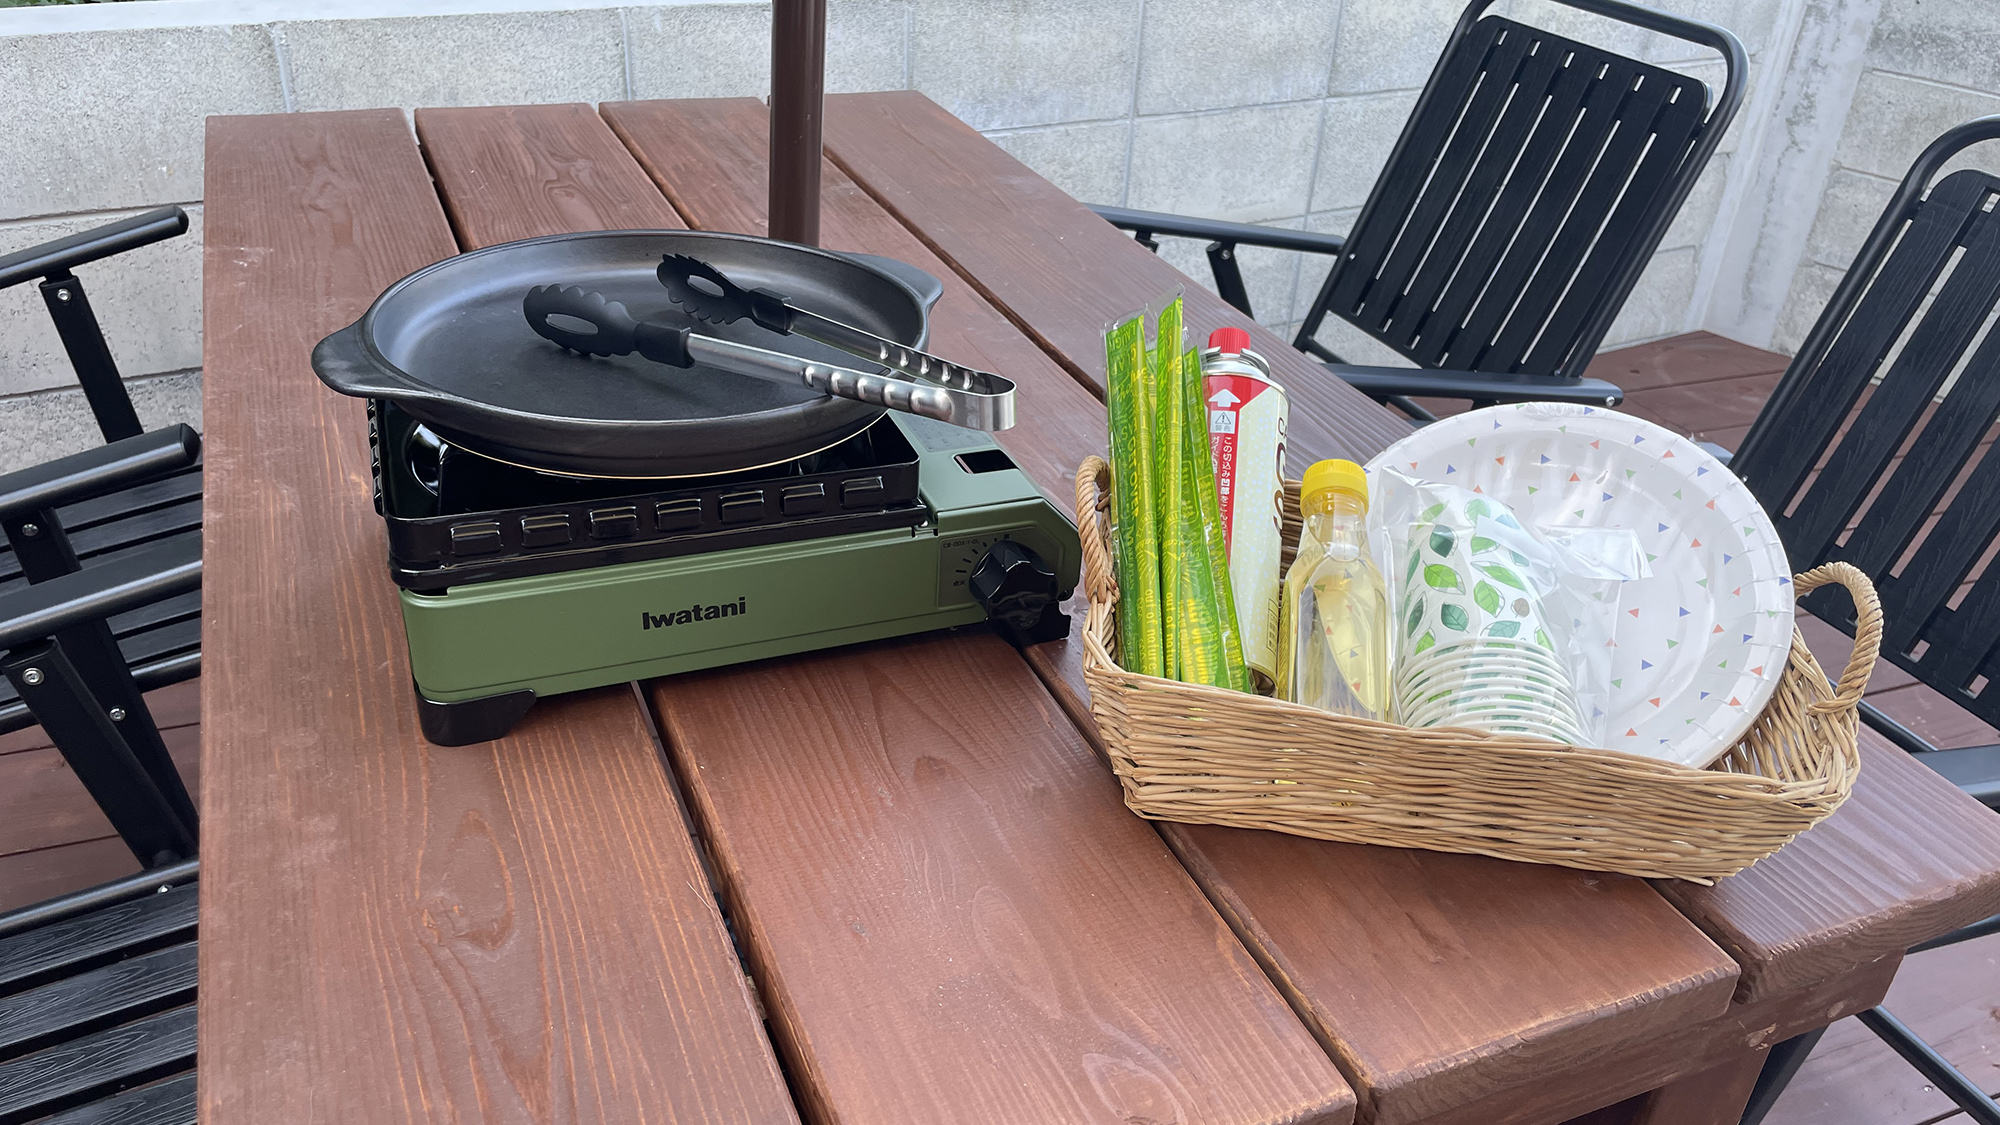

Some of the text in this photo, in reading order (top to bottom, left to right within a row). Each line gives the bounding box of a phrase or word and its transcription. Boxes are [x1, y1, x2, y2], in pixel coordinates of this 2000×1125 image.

[1145, 588, 1156, 608] out
[1166, 592, 1176, 611] out
[642, 596, 746, 630] Iwatani
[1146, 610, 1158, 626] of
[1166, 614, 1176, 628] of
